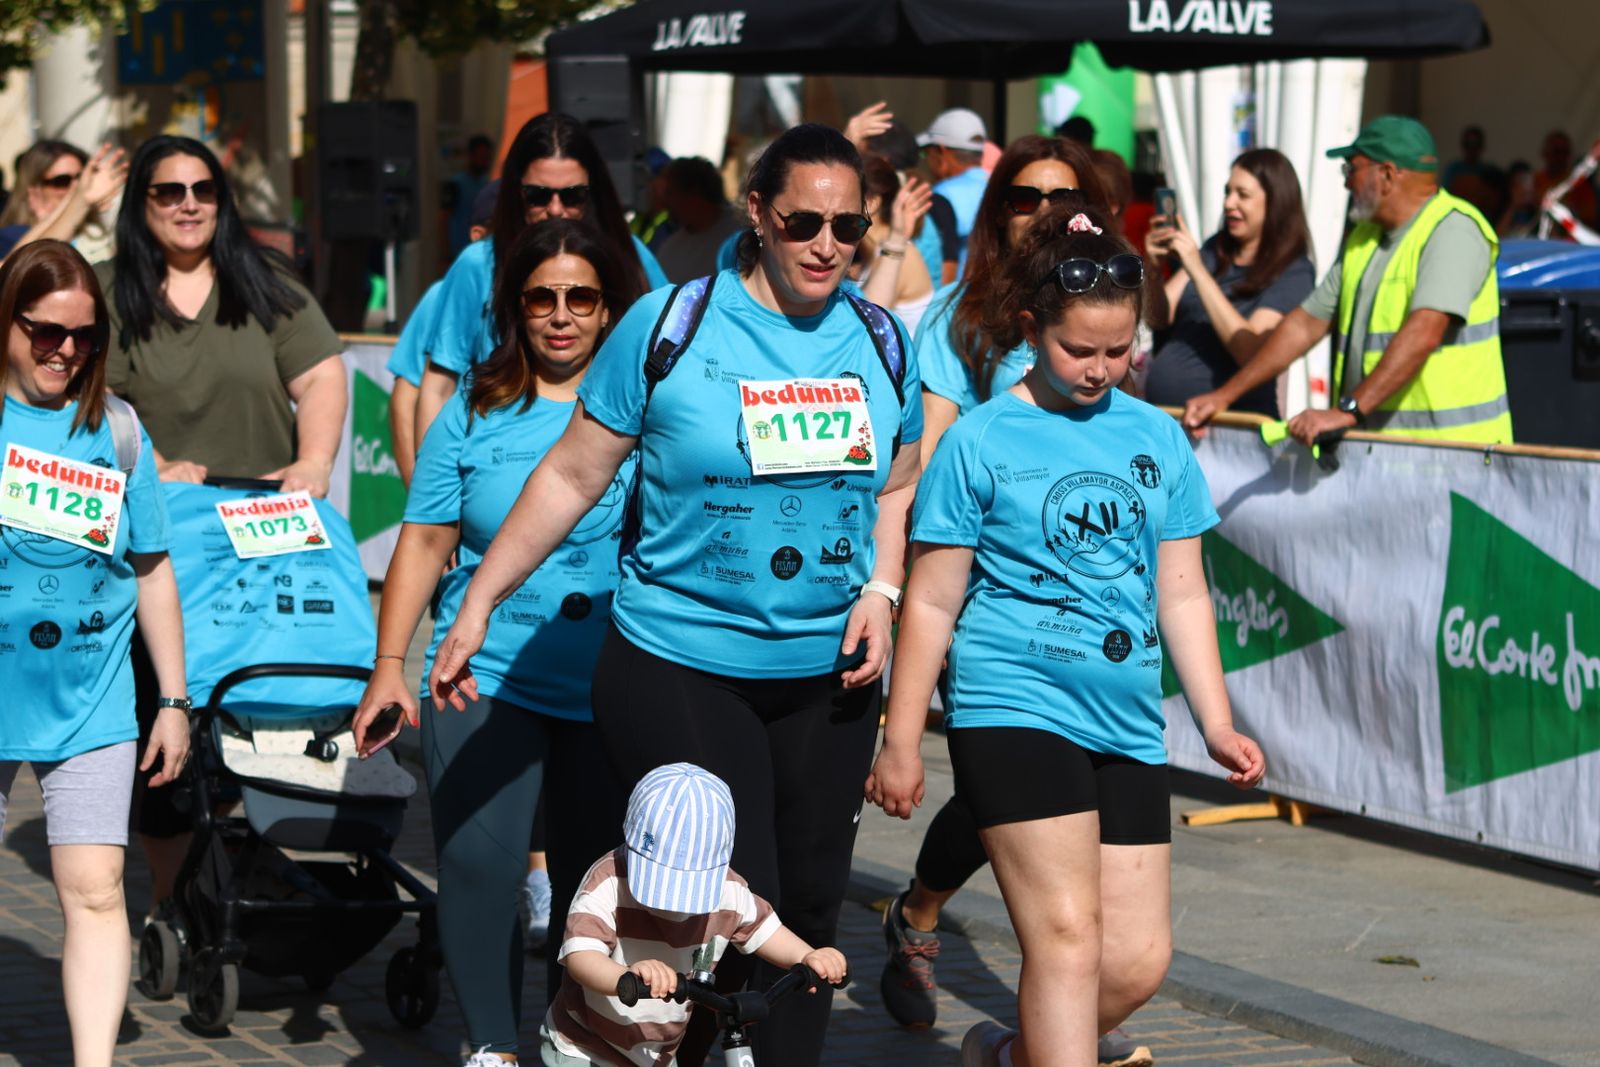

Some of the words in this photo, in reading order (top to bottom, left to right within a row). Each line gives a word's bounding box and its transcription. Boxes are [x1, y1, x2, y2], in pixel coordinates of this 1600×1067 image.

[1129, 0, 1171, 32] LA
[1173, 0, 1273, 35] SALVE
[742, 383, 862, 408] bedunia
[771, 410, 852, 442] 1127
[8, 448, 121, 495] bedunia
[1013, 473, 1050, 483] Villamayor
[25, 481, 104, 522] 1128
[1050, 485, 1068, 506] CROSS
[1066, 476, 1108, 488] VILLAMAYOR
[1110, 481, 1136, 502] ASPACE
[219, 497, 310, 518] bedunia
[703, 501, 755, 515] Hergaher
[1064, 500, 1120, 542] XII
[245, 515, 308, 539] 1073
[715, 566, 756, 580] SUMESAL
[1044, 643, 1087, 659] SUMESAL
[1443, 605, 1475, 669] El
[1476, 614, 1558, 686] Corte
